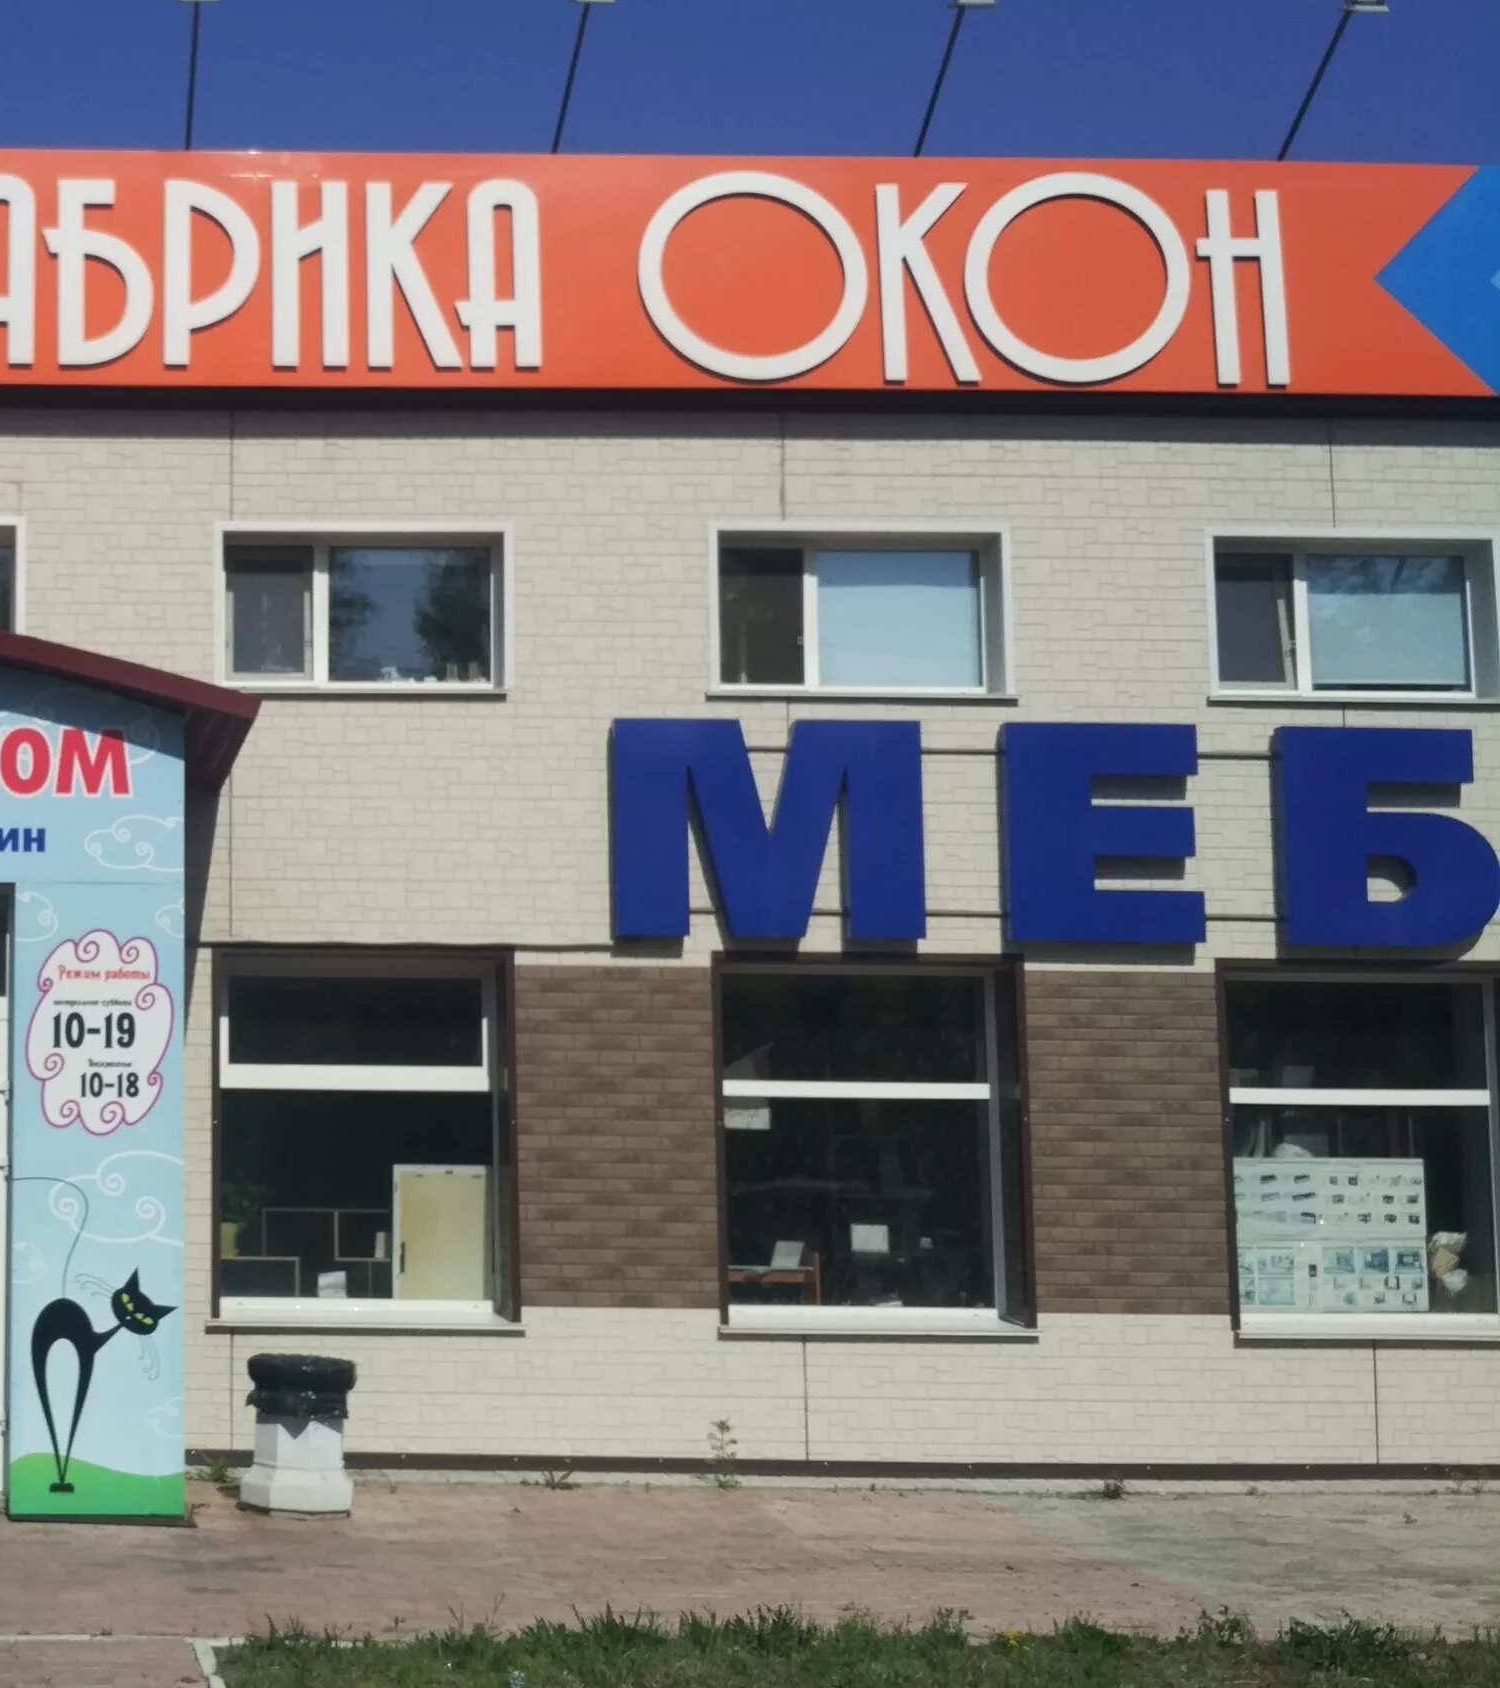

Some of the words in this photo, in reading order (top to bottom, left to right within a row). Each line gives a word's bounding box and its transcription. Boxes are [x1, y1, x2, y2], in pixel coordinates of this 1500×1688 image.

[636, 170, 1292, 390] ОКОН
[57, 965, 101, 982] Режим
[104, 966, 151, 982] работы
[52, 1011, 136, 1049] 10-19
[80, 1072, 140, 1098] 10-18
